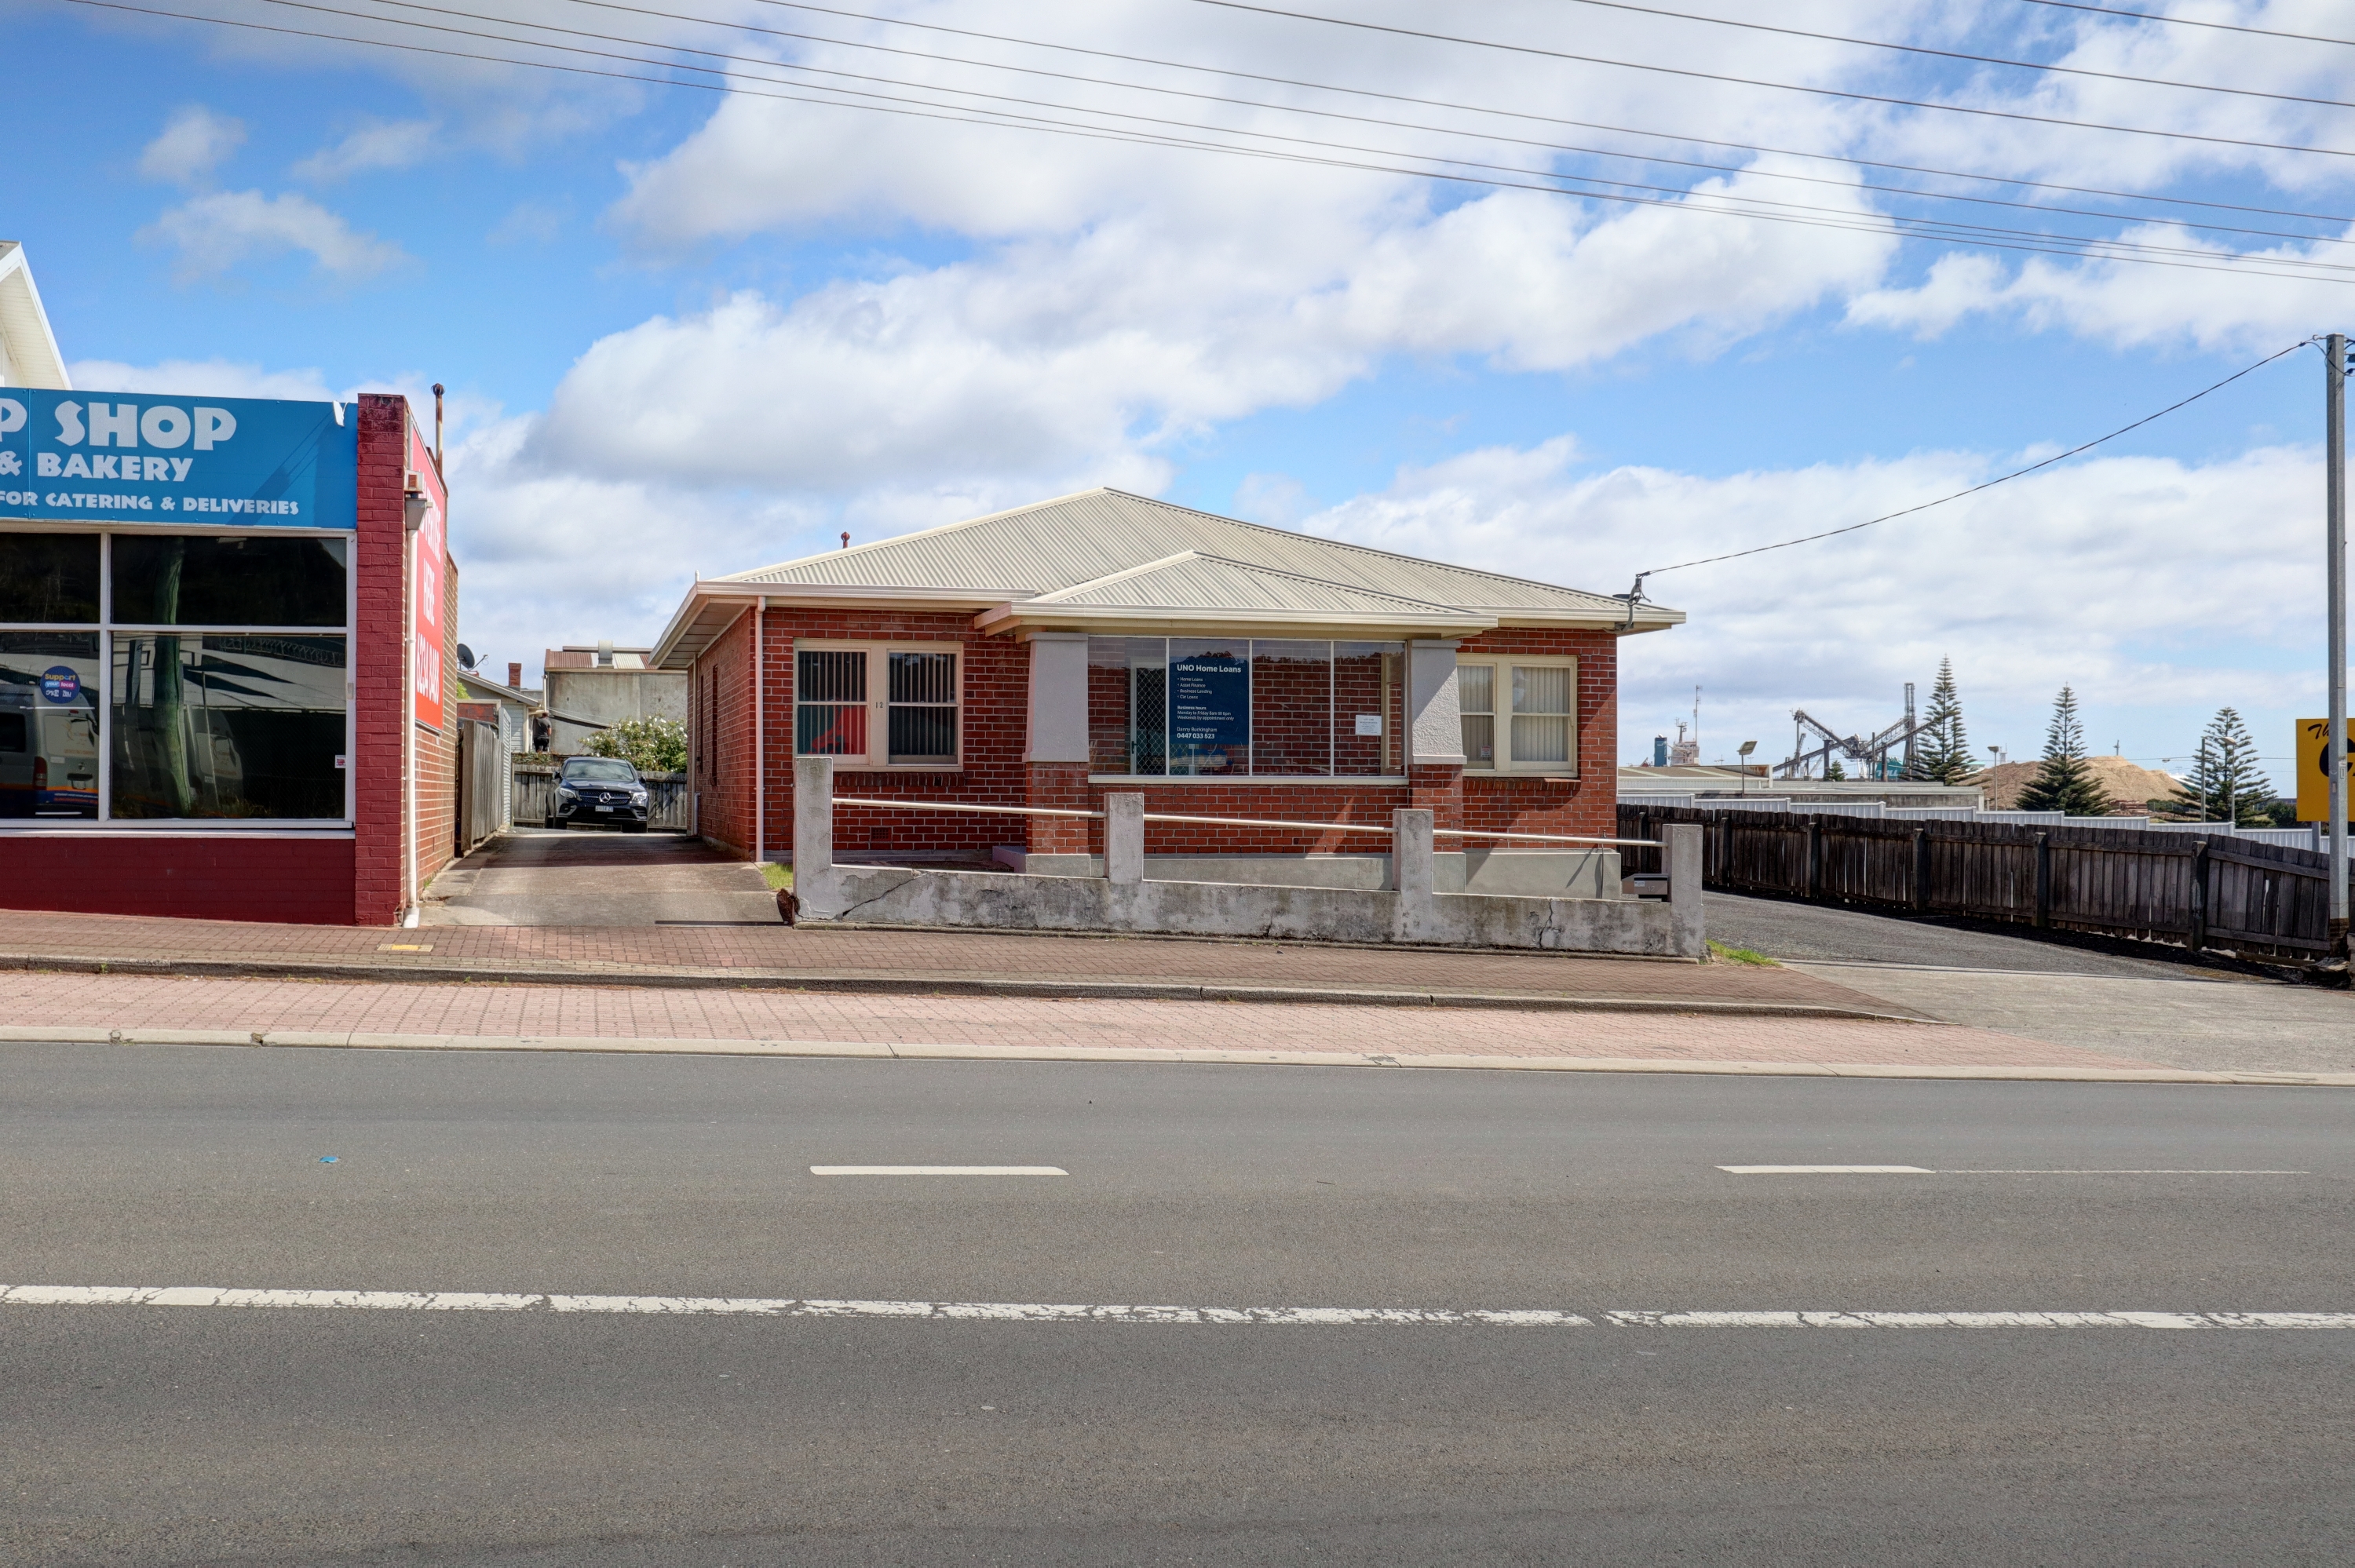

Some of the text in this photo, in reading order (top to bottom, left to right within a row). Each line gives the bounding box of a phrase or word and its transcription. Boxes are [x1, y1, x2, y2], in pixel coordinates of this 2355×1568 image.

[54, 400, 237, 450] SHOP
[0, 450, 193, 482] & BAKERY
[46, 493, 153, 510] CATERING
[160, 496, 176, 511] &
[183, 497, 299, 515] DELIVERIES
[423, 558, 435, 626] HERE
